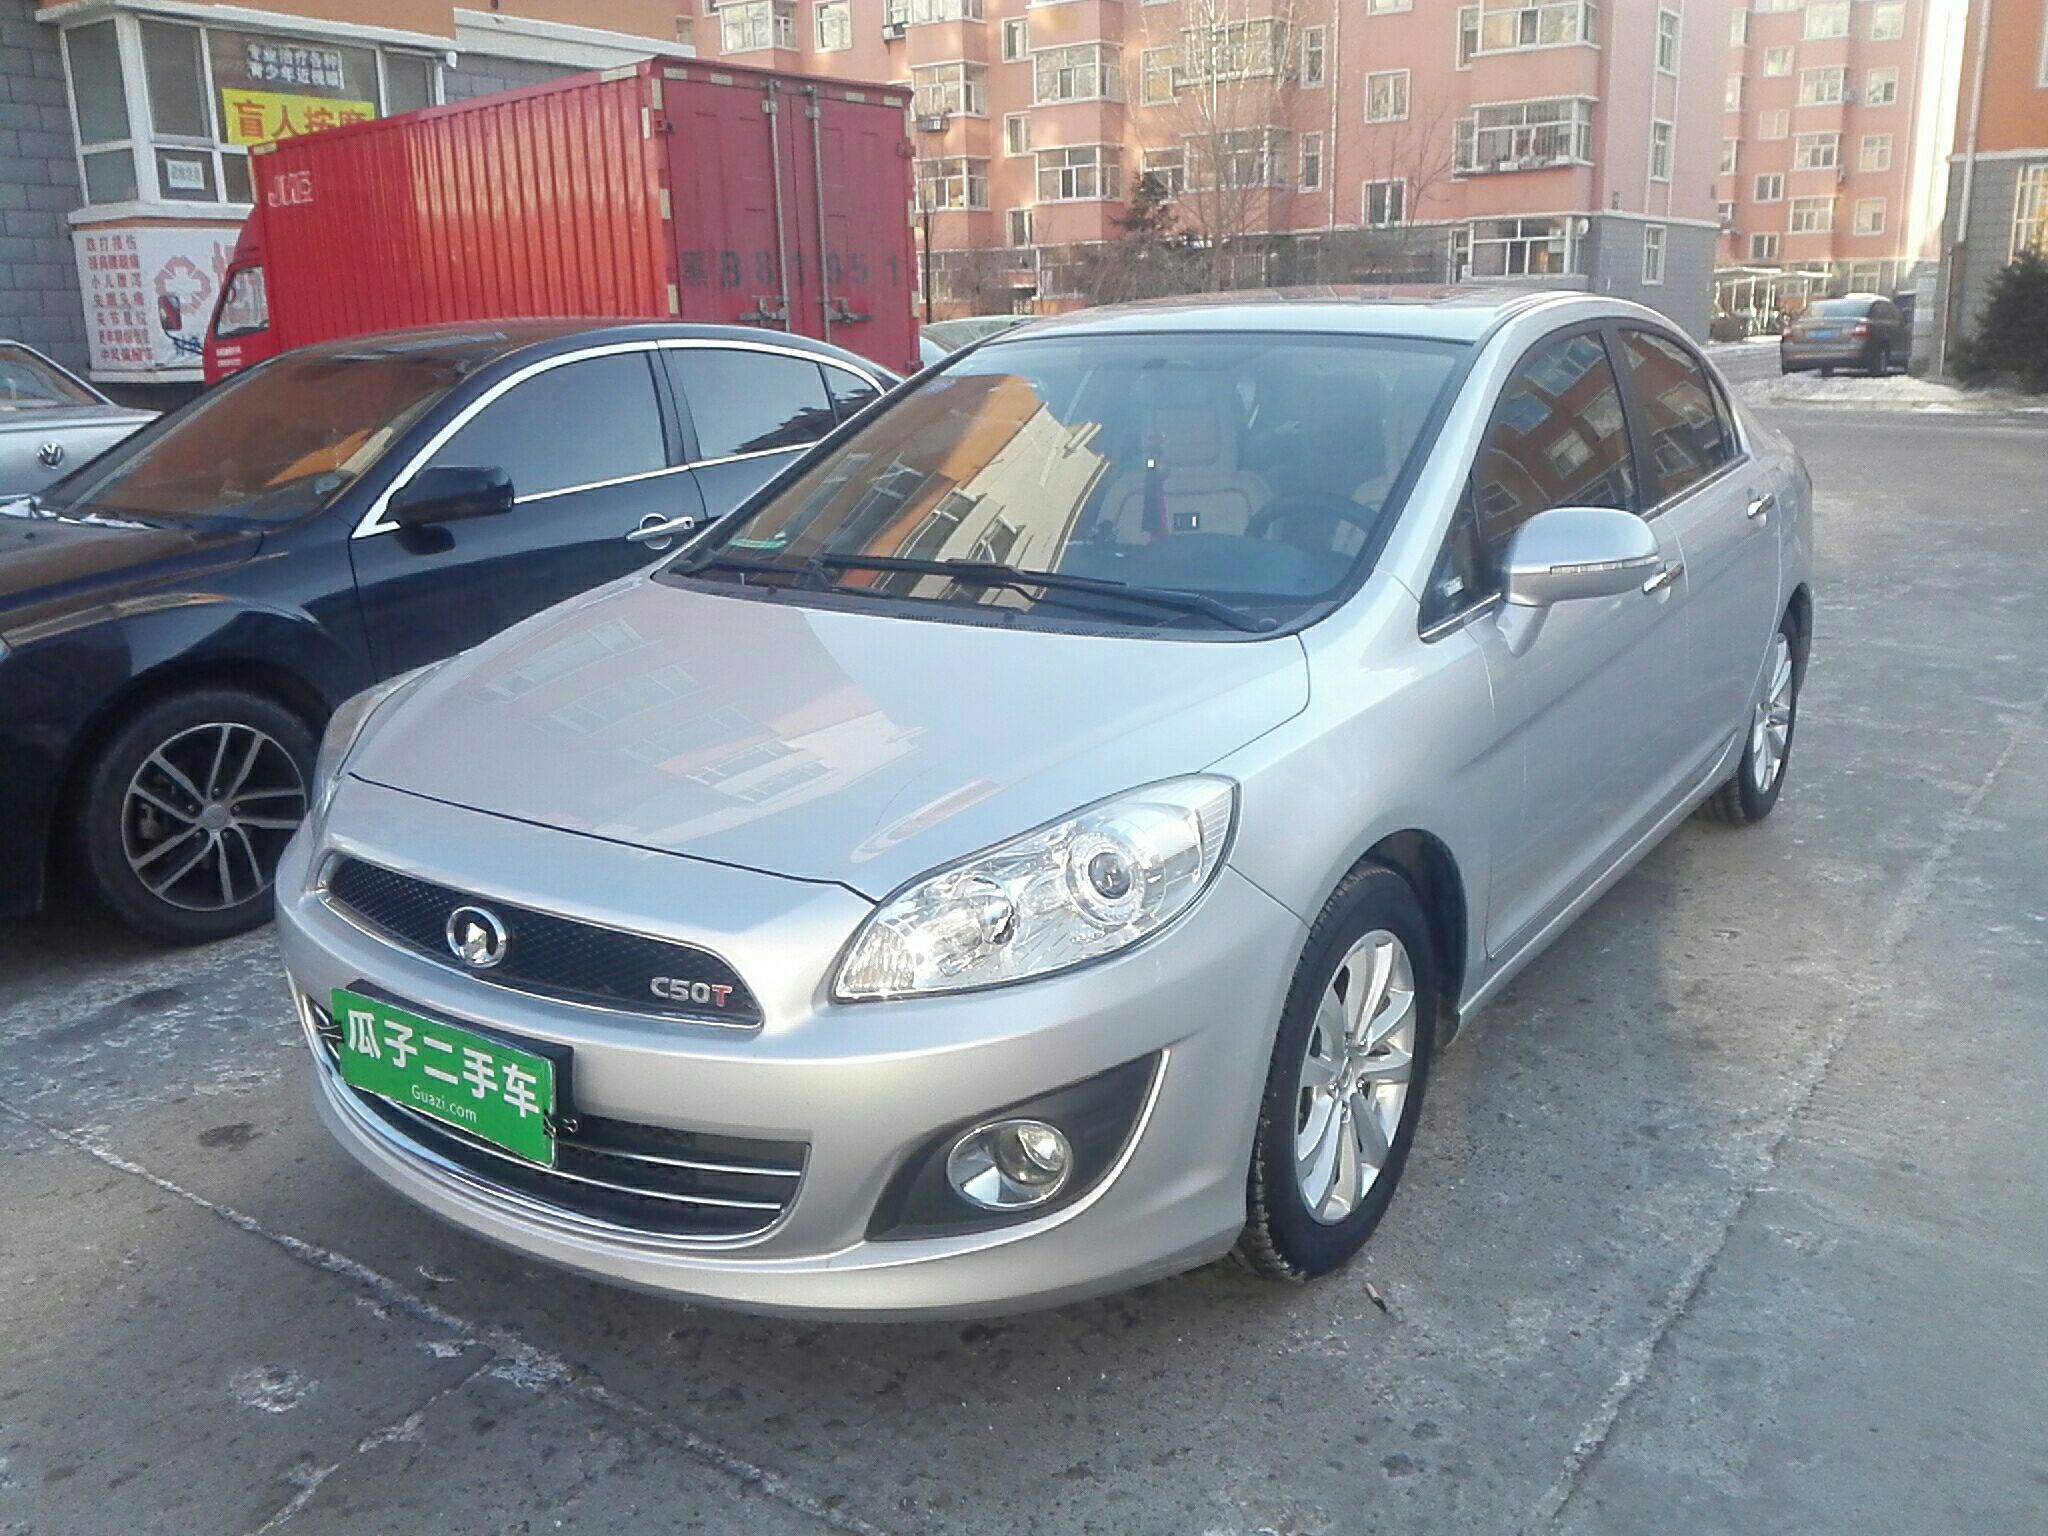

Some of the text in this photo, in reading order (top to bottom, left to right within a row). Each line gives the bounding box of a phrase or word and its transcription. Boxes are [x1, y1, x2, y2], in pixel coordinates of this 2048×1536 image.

[650, 976, 733, 1007] C50T
[348, 1009, 540, 1118] 瓜子二手车
[411, 1084, 477, 1123] Guazi.com
